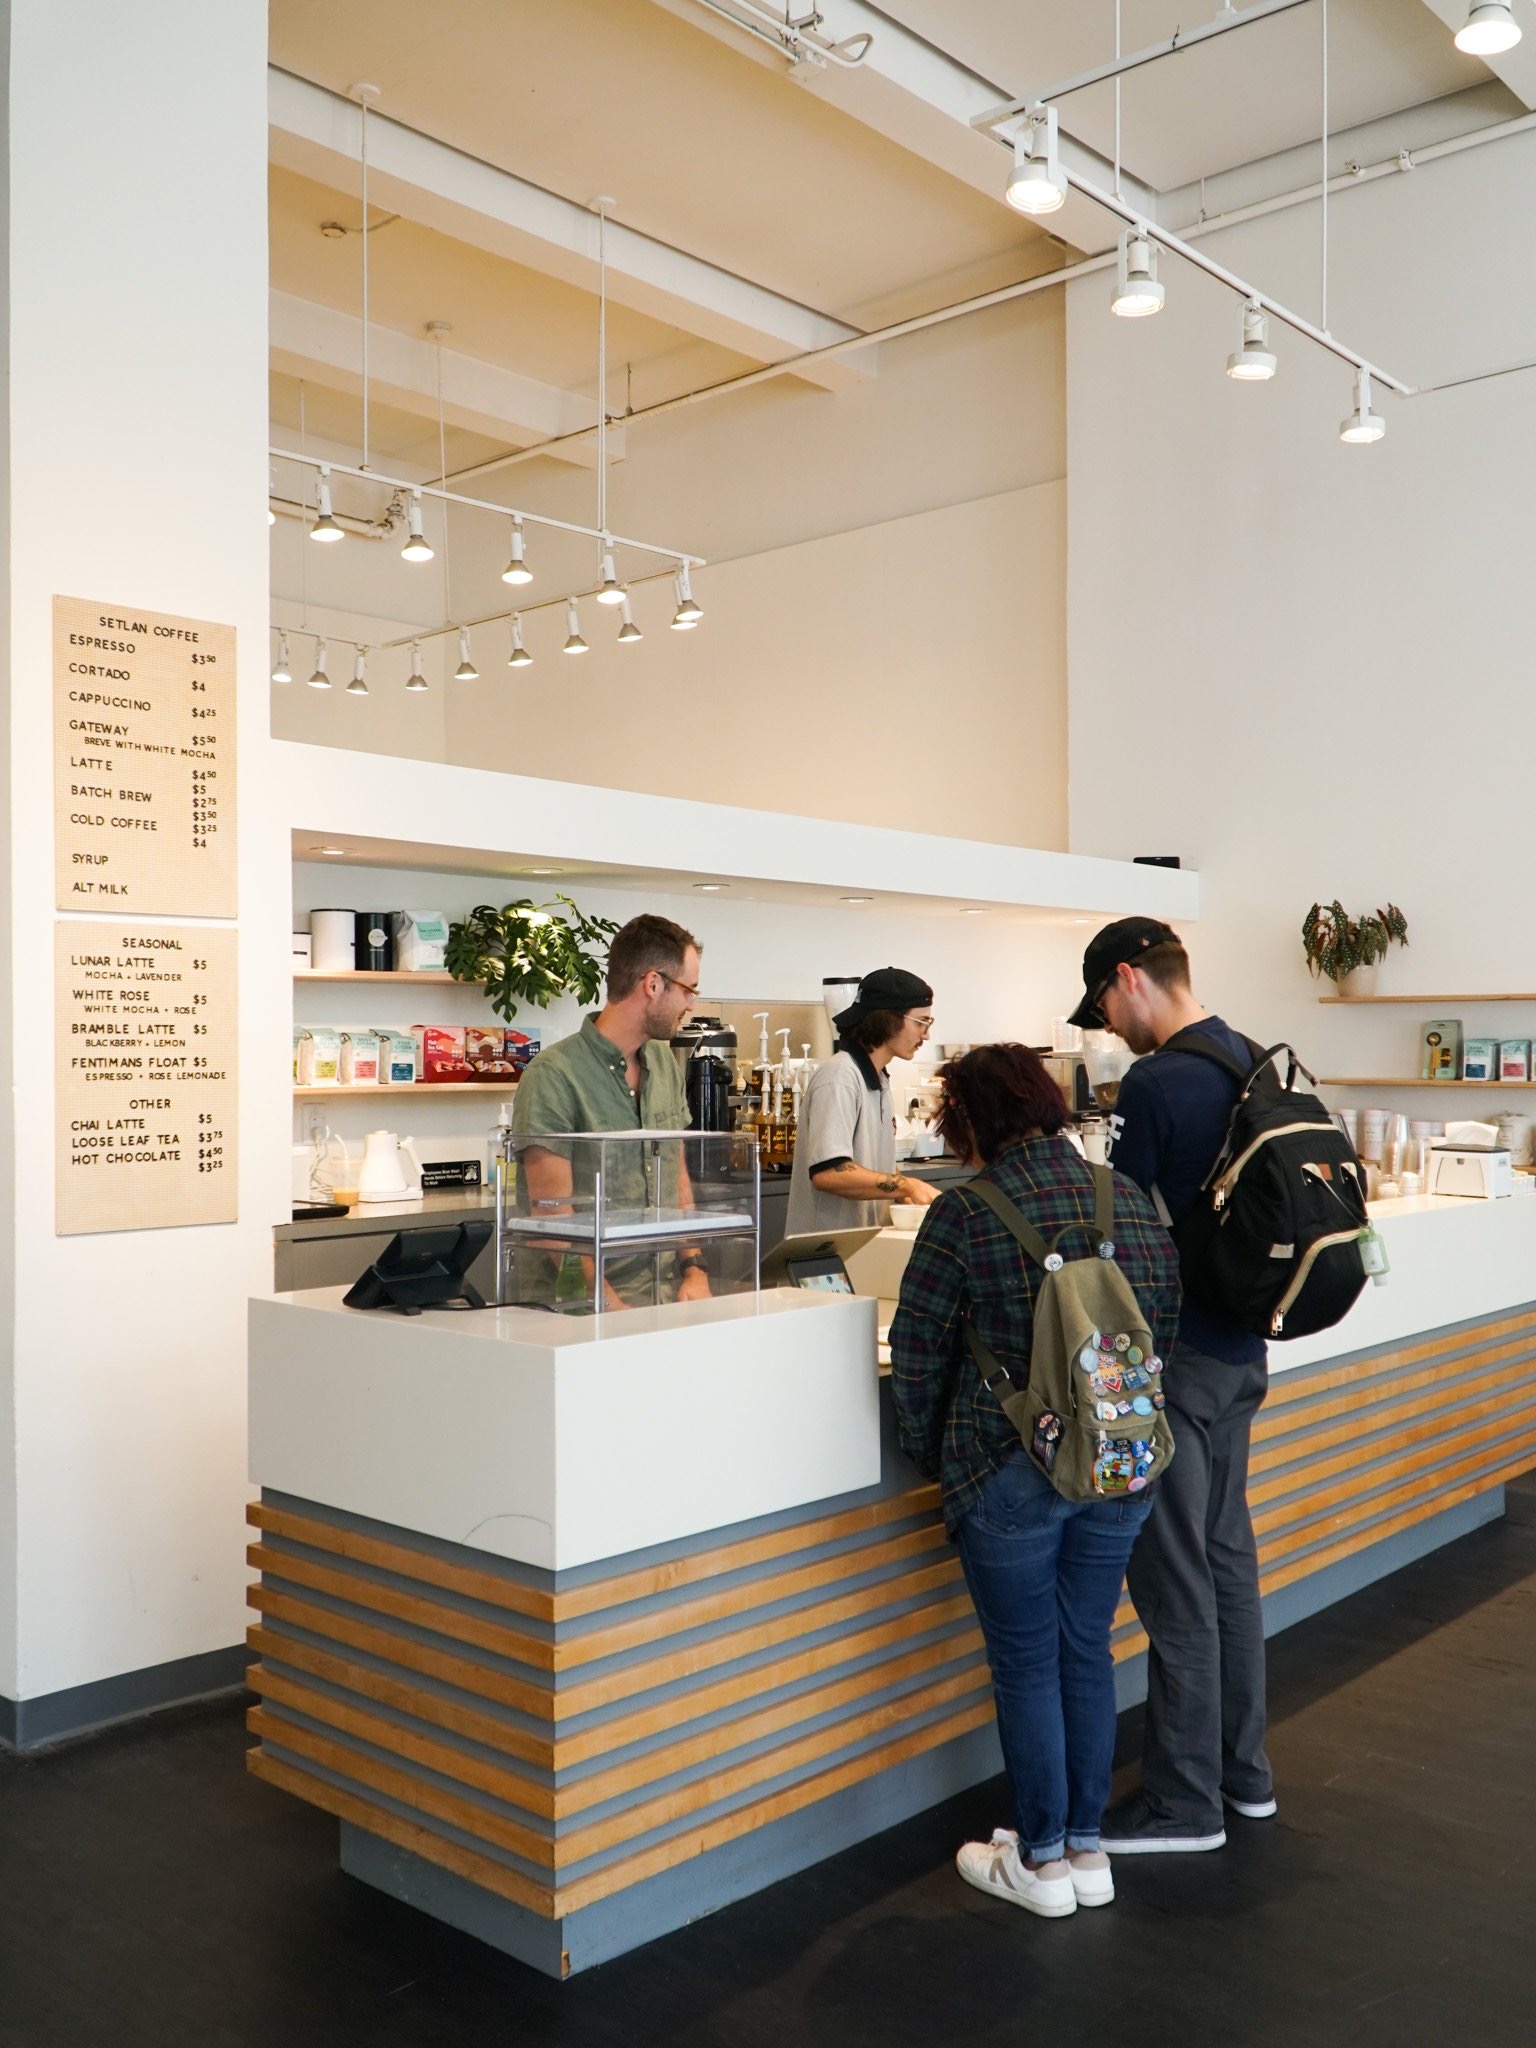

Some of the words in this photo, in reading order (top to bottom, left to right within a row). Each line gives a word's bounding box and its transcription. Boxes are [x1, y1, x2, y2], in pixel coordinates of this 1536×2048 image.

[99, 616, 148, 634] SETLAN
[153, 625, 200, 643] COFFEE
[69, 633, 136, 654] ESPRESSO
[68, 662, 131, 681] CORTADO
[191, 680, 207, 692] $4
[68, 690, 152, 712] CAPPUCCINO
[69, 719, 129, 736] GATEWAY
[84, 736, 112, 748] BREVE
[115, 740, 142, 751] WITH
[143, 743, 176, 756] WHITE
[180, 748, 217, 760] MOCHA
[70, 756, 114, 771] LATTE
[70, 784, 113, 799] BATCH
[119, 789, 153, 803] BREW
[191, 784, 207, 795] $5
[70, 813, 105, 826] COLD
[110, 817, 158, 831] COFFEE
[192, 837, 208, 849] $4
[71, 853, 109, 865] SYRUP
[72, 882, 95, 893] ALT
[98, 883, 129, 896] MILK
[122, 937, 183, 950] SEASONAL
[70, 955, 111, 966] LUNAR
[116, 957, 155, 969] LATTE
[192, 959, 208, 970] $5
[84, 971, 123, 980] MOCHA
[135, 972, 183, 982] LAVENDER
[72, 989, 114, 1000] WHITE
[119, 990, 150, 1001] ROSE
[192, 994, 208, 1005] $5
[83, 1004, 118, 1014] WHITE
[122, 1005, 160, 1014] MOCHA
[173, 1006, 197, 1015] ROSE
[71, 1023, 130, 1035] BRAMBLE
[138, 1024, 176, 1035] LATTE
[192, 1024, 208, 1035] $5
[85, 1039, 143, 1048] BLACKBERRY
[153, 1039, 187, 1048] LEMON
[71, 1057, 143, 1069] FENTIMANS
[148, 1057, 187, 1068] FLOAT
[192, 1056, 208, 1068] $5
[85, 1072, 134, 1081] ESPRESSO
[148, 1071, 172, 1081] ROSE
[176, 1071, 227, 1080] LEMONADE
[129, 1098, 172, 1110] OTHER
[70, 1120, 100, 1131] CHAI
[106, 1118, 146, 1130] LATTE
[198, 1113, 213, 1124] $5
[72, 1136, 114, 1148] LOOSE
[120, 1135, 150, 1146] LEAF
[157, 1134, 180, 1145] TEA
[71, 1154, 100, 1166] HOT
[105, 1150, 182, 1164] CHOCOLATE
